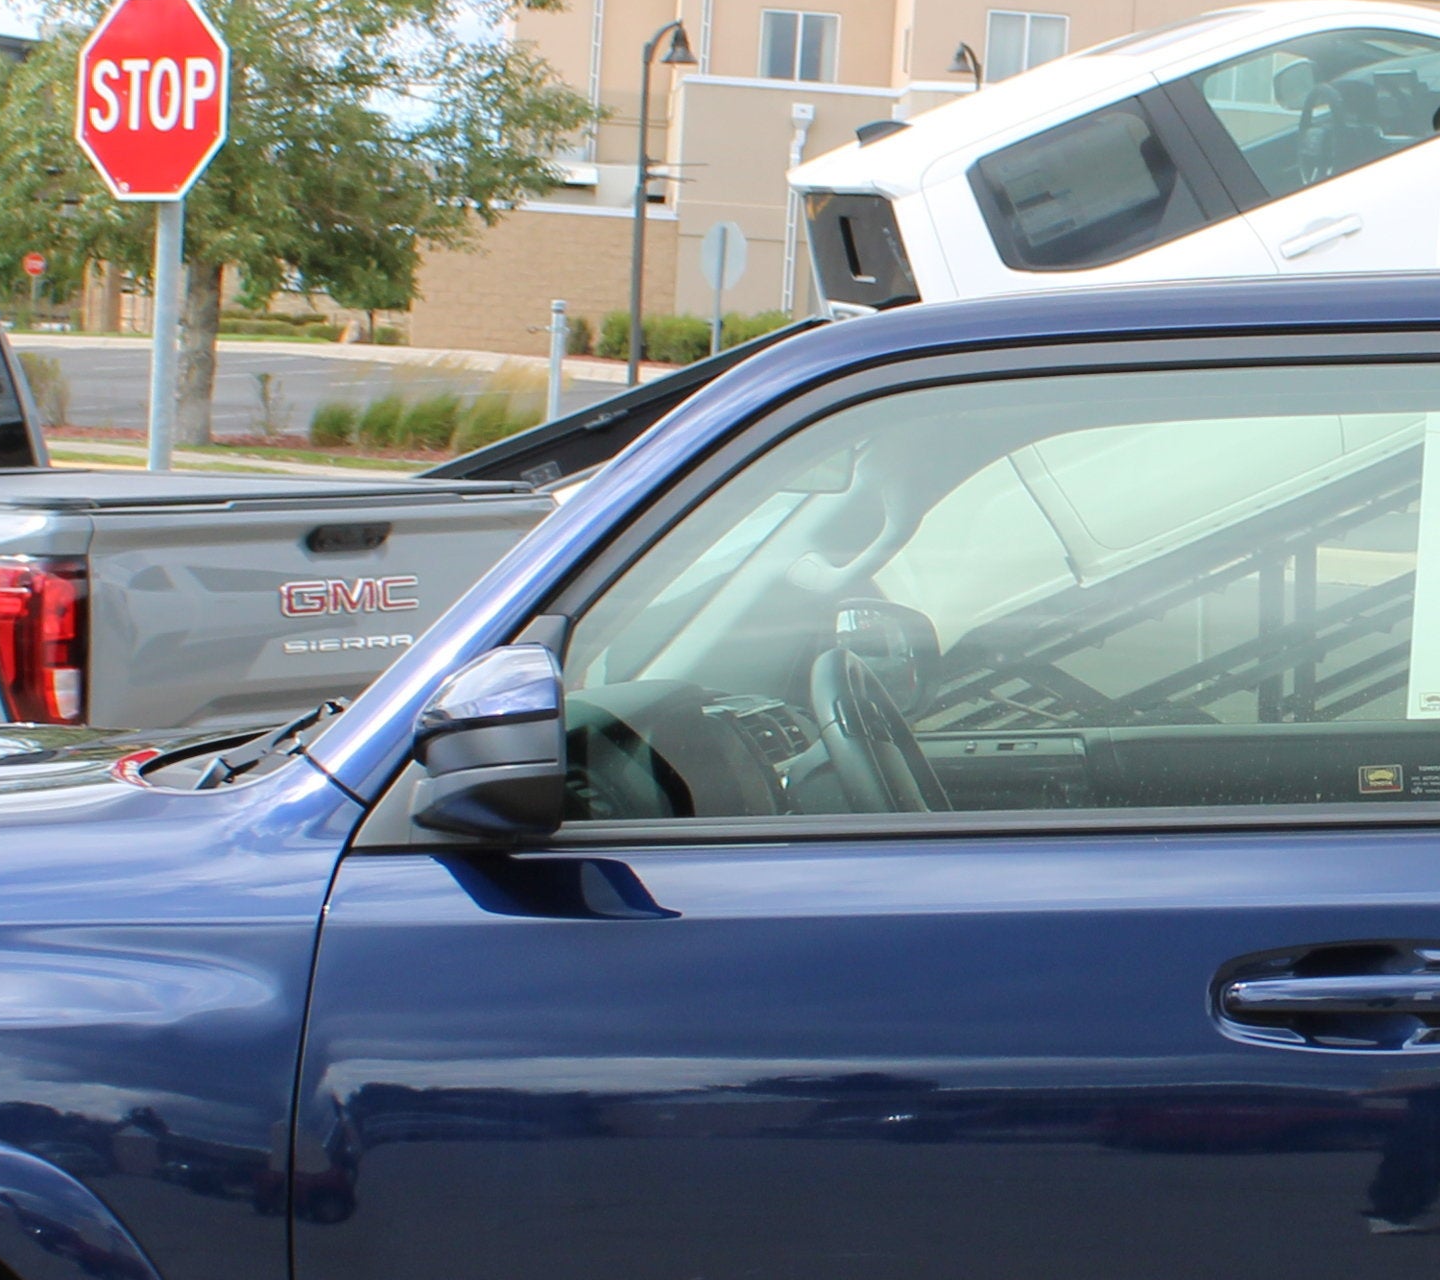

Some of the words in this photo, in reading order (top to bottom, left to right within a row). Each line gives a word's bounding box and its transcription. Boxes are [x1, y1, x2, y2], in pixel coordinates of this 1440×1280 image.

[89, 56, 216, 132] STOP
[279, 575, 420, 617] GMC
[283, 634, 414, 653] SIERRA
